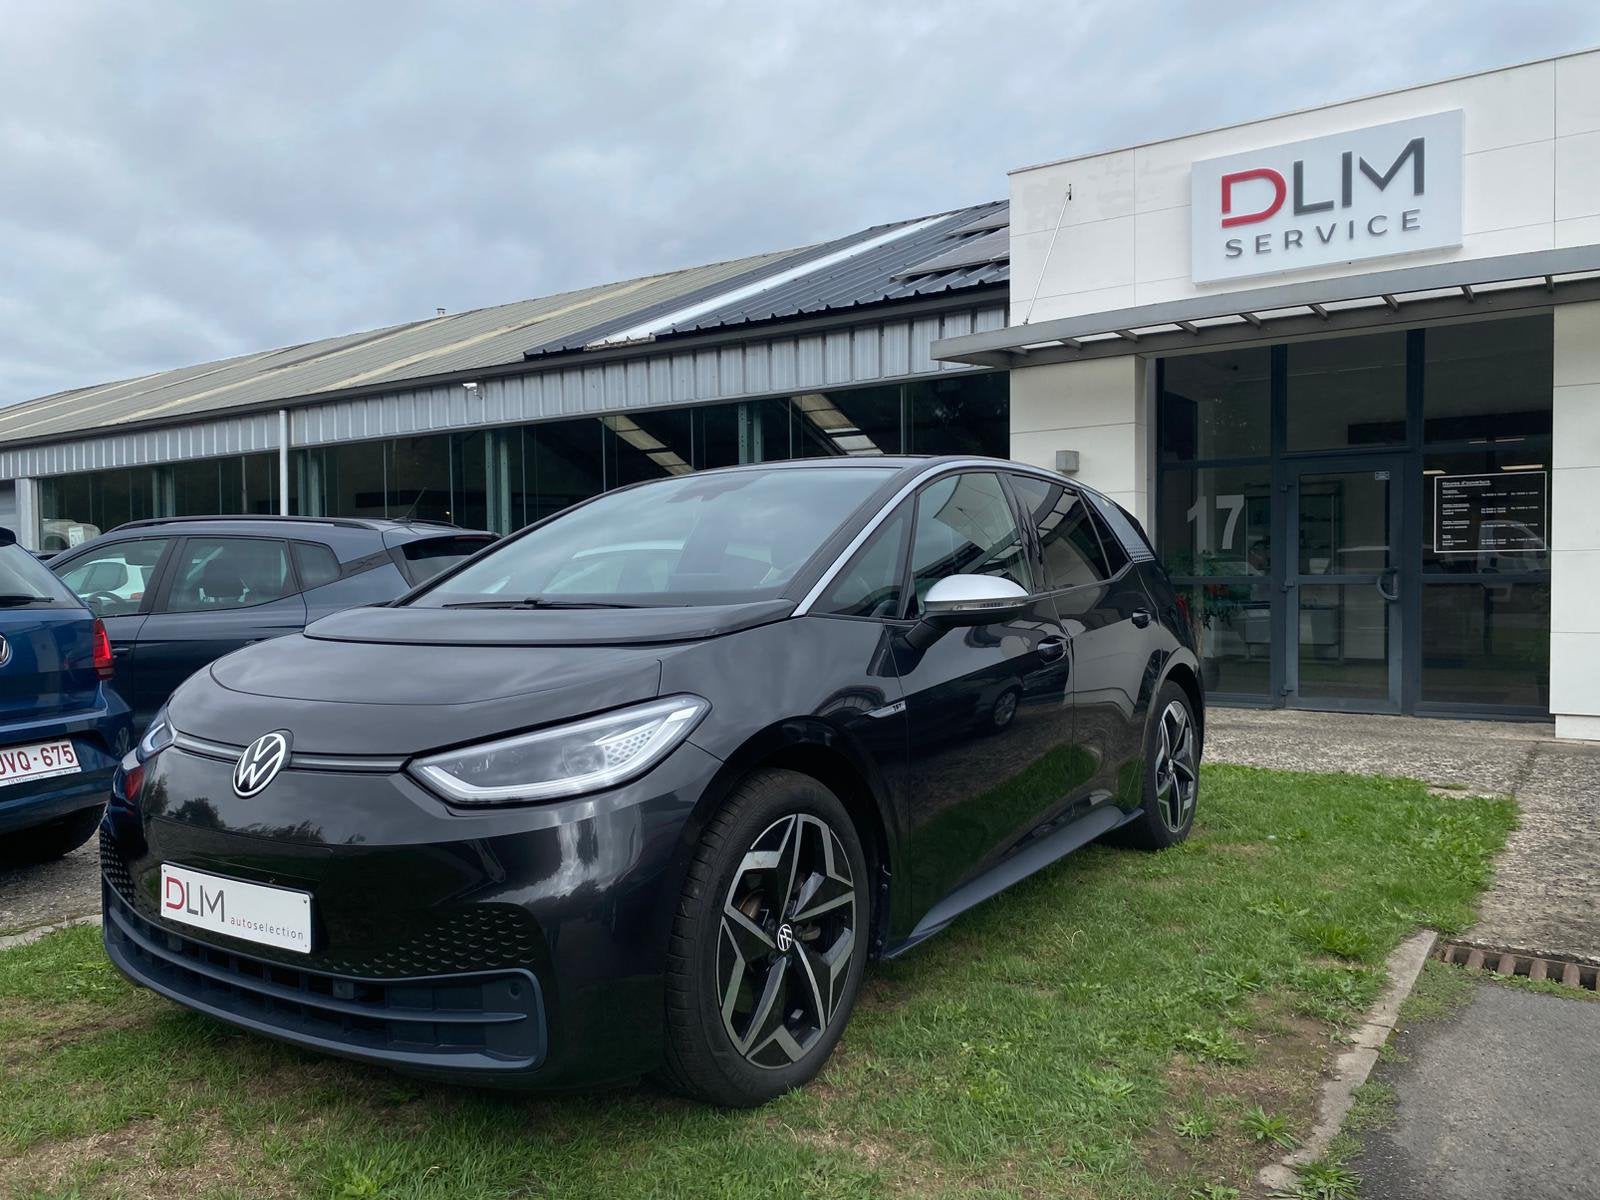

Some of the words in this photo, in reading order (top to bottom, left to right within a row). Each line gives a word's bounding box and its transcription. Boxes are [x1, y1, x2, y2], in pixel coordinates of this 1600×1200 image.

[1221, 137, 1425, 228] DLM
[1225, 209, 1421, 258] SERVICE
[1187, 494, 1244, 554] 17
[166, 876, 225, 922] DLM
[230, 916, 304, 940] autoselection
